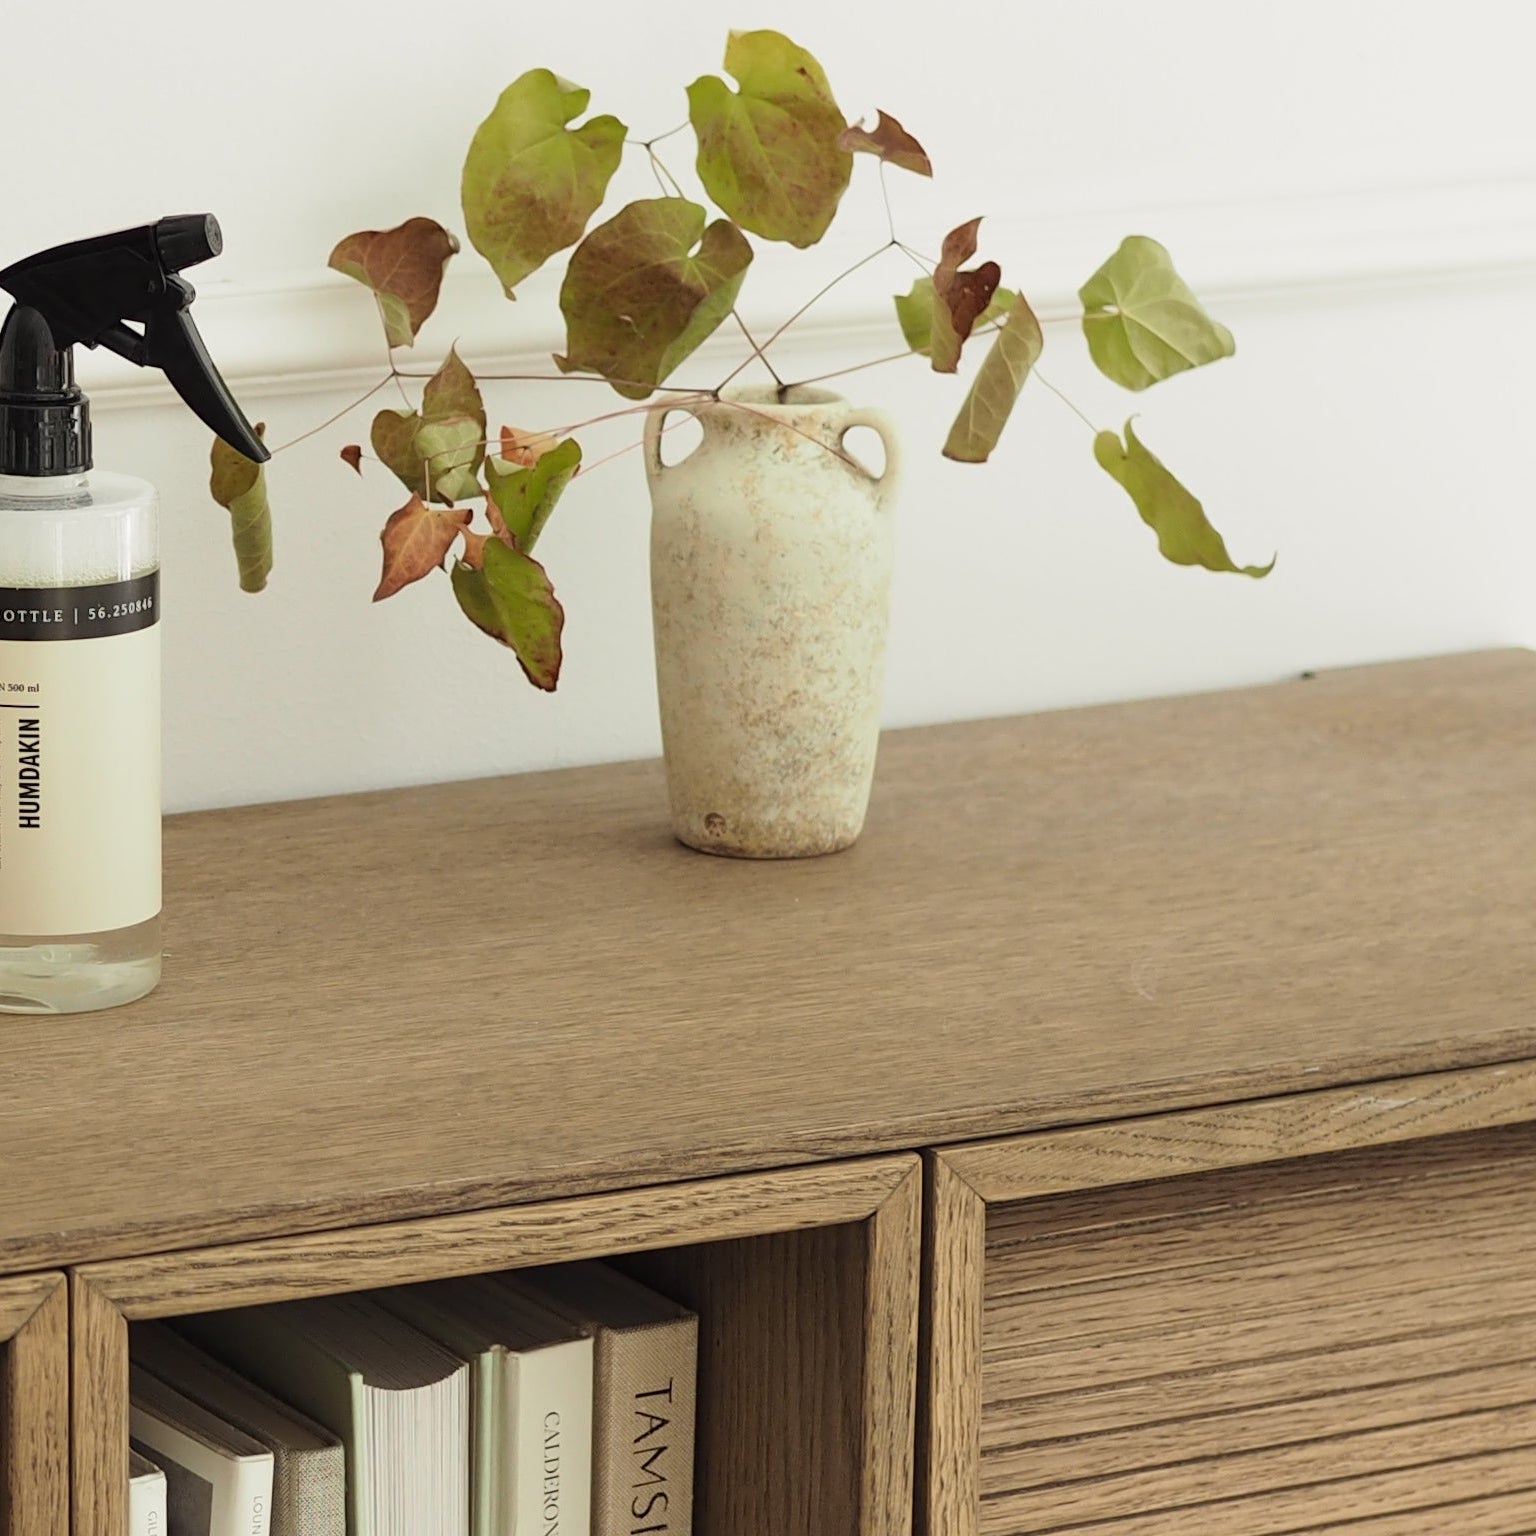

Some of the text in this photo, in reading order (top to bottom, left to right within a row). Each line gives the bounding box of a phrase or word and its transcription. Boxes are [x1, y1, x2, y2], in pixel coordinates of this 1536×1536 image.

[87, 596, 154, 620] 56.250846
[7, 683, 25, 693] 500
[27, 683, 40, 693] ml
[18, 718, 40, 829] HUMDAKIN
